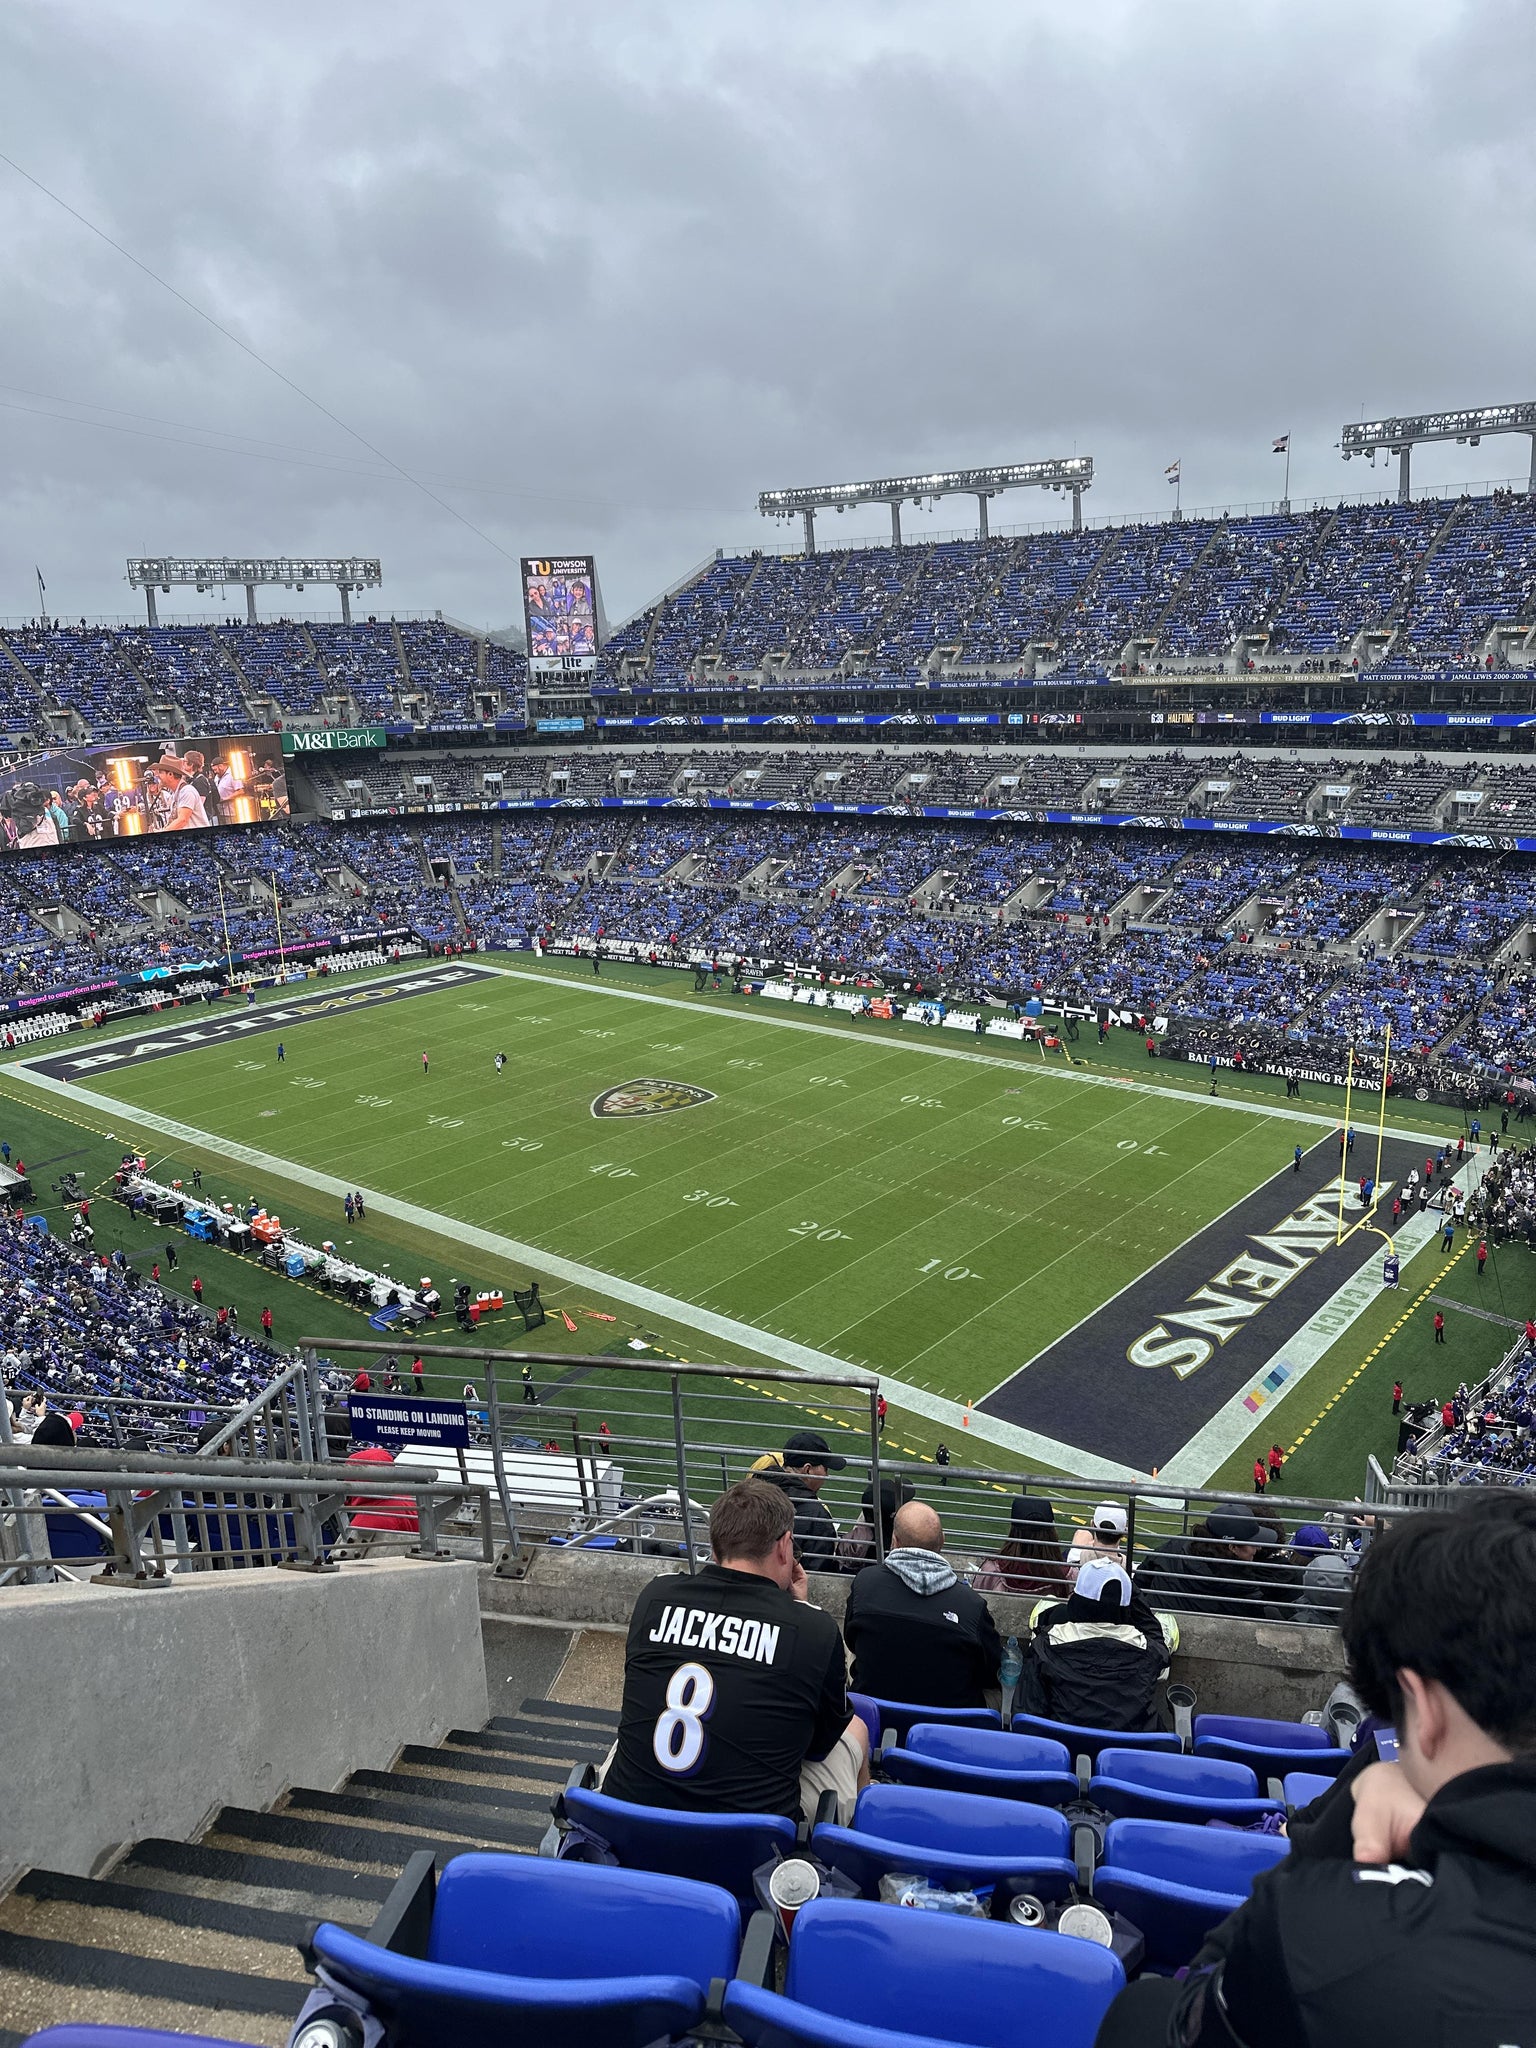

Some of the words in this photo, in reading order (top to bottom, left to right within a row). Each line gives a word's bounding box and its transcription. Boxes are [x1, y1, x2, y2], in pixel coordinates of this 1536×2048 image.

[528, 560, 551, 576] TU
[552, 561, 587, 569] TOWSON
[561, 657, 582, 668] Lite
[1026, 715, 1029, 723] 7
[1068, 714, 1074, 723] 24
[1151, 714, 1164, 723] 6:39
[1167, 713, 1194, 723] HALFTIME
[292, 731, 335, 750] M&T
[336, 730, 377, 748] Bank
[114, 796, 130, 811] 89
[481, 802, 488, 810] 20
[243, 950, 268, 960] Designed
[331, 956, 387, 974] MARYLAND
[18, 994, 47, 1007] Designed
[55, 986, 90, 999] outperform
[101, 980, 118, 988] Index
[60, 968, 477, 1073] BALTIMORE
[239, 1060, 266, 1071] 10
[726, 1058, 764, 1070] 50
[297, 1076, 326, 1088] 20
[958, 1054, 1066, 1078] INTERCEPT
[1072, 1074, 1162, 1094] CANCER
[1266, 1064, 1327, 1082] MARCHING
[1334, 1074, 1382, 1091] RAVENS
[642, 1080, 706, 1098] RAVENS
[358, 1096, 392, 1108] 30
[900, 1094, 938, 1107] 30
[428, 1116, 464, 1129] 40
[1002, 1116, 1048, 1130] 20
[128, 1112, 202, 1144] INTERCEPT
[200, 1136, 266, 1164] CANCER
[502, 1137, 543, 1152] 50
[1116, 1140, 1160, 1156] 10
[588, 1162, 632, 1178] 40
[682, 1189, 731, 1208] 30
[788, 1221, 842, 1242] 20
[915, 1258, 973, 1280] 10
[1126, 1174, 1397, 1381] RAVENS
[1308, 1288, 1370, 1336] CATCH
[352, 1406, 364, 1418] NO
[366, 1408, 409, 1422] STANDING
[411, 1411, 424, 1423] ON
[426, 1412, 465, 1426] LANDING
[377, 1425, 399, 1435] PLEASE
[400, 1427, 415, 1436] KEEP
[417, 1429, 441, 1438] MOVING
[649, 1605, 780, 1666] JACKSON
[653, 1662, 715, 1774] 8
